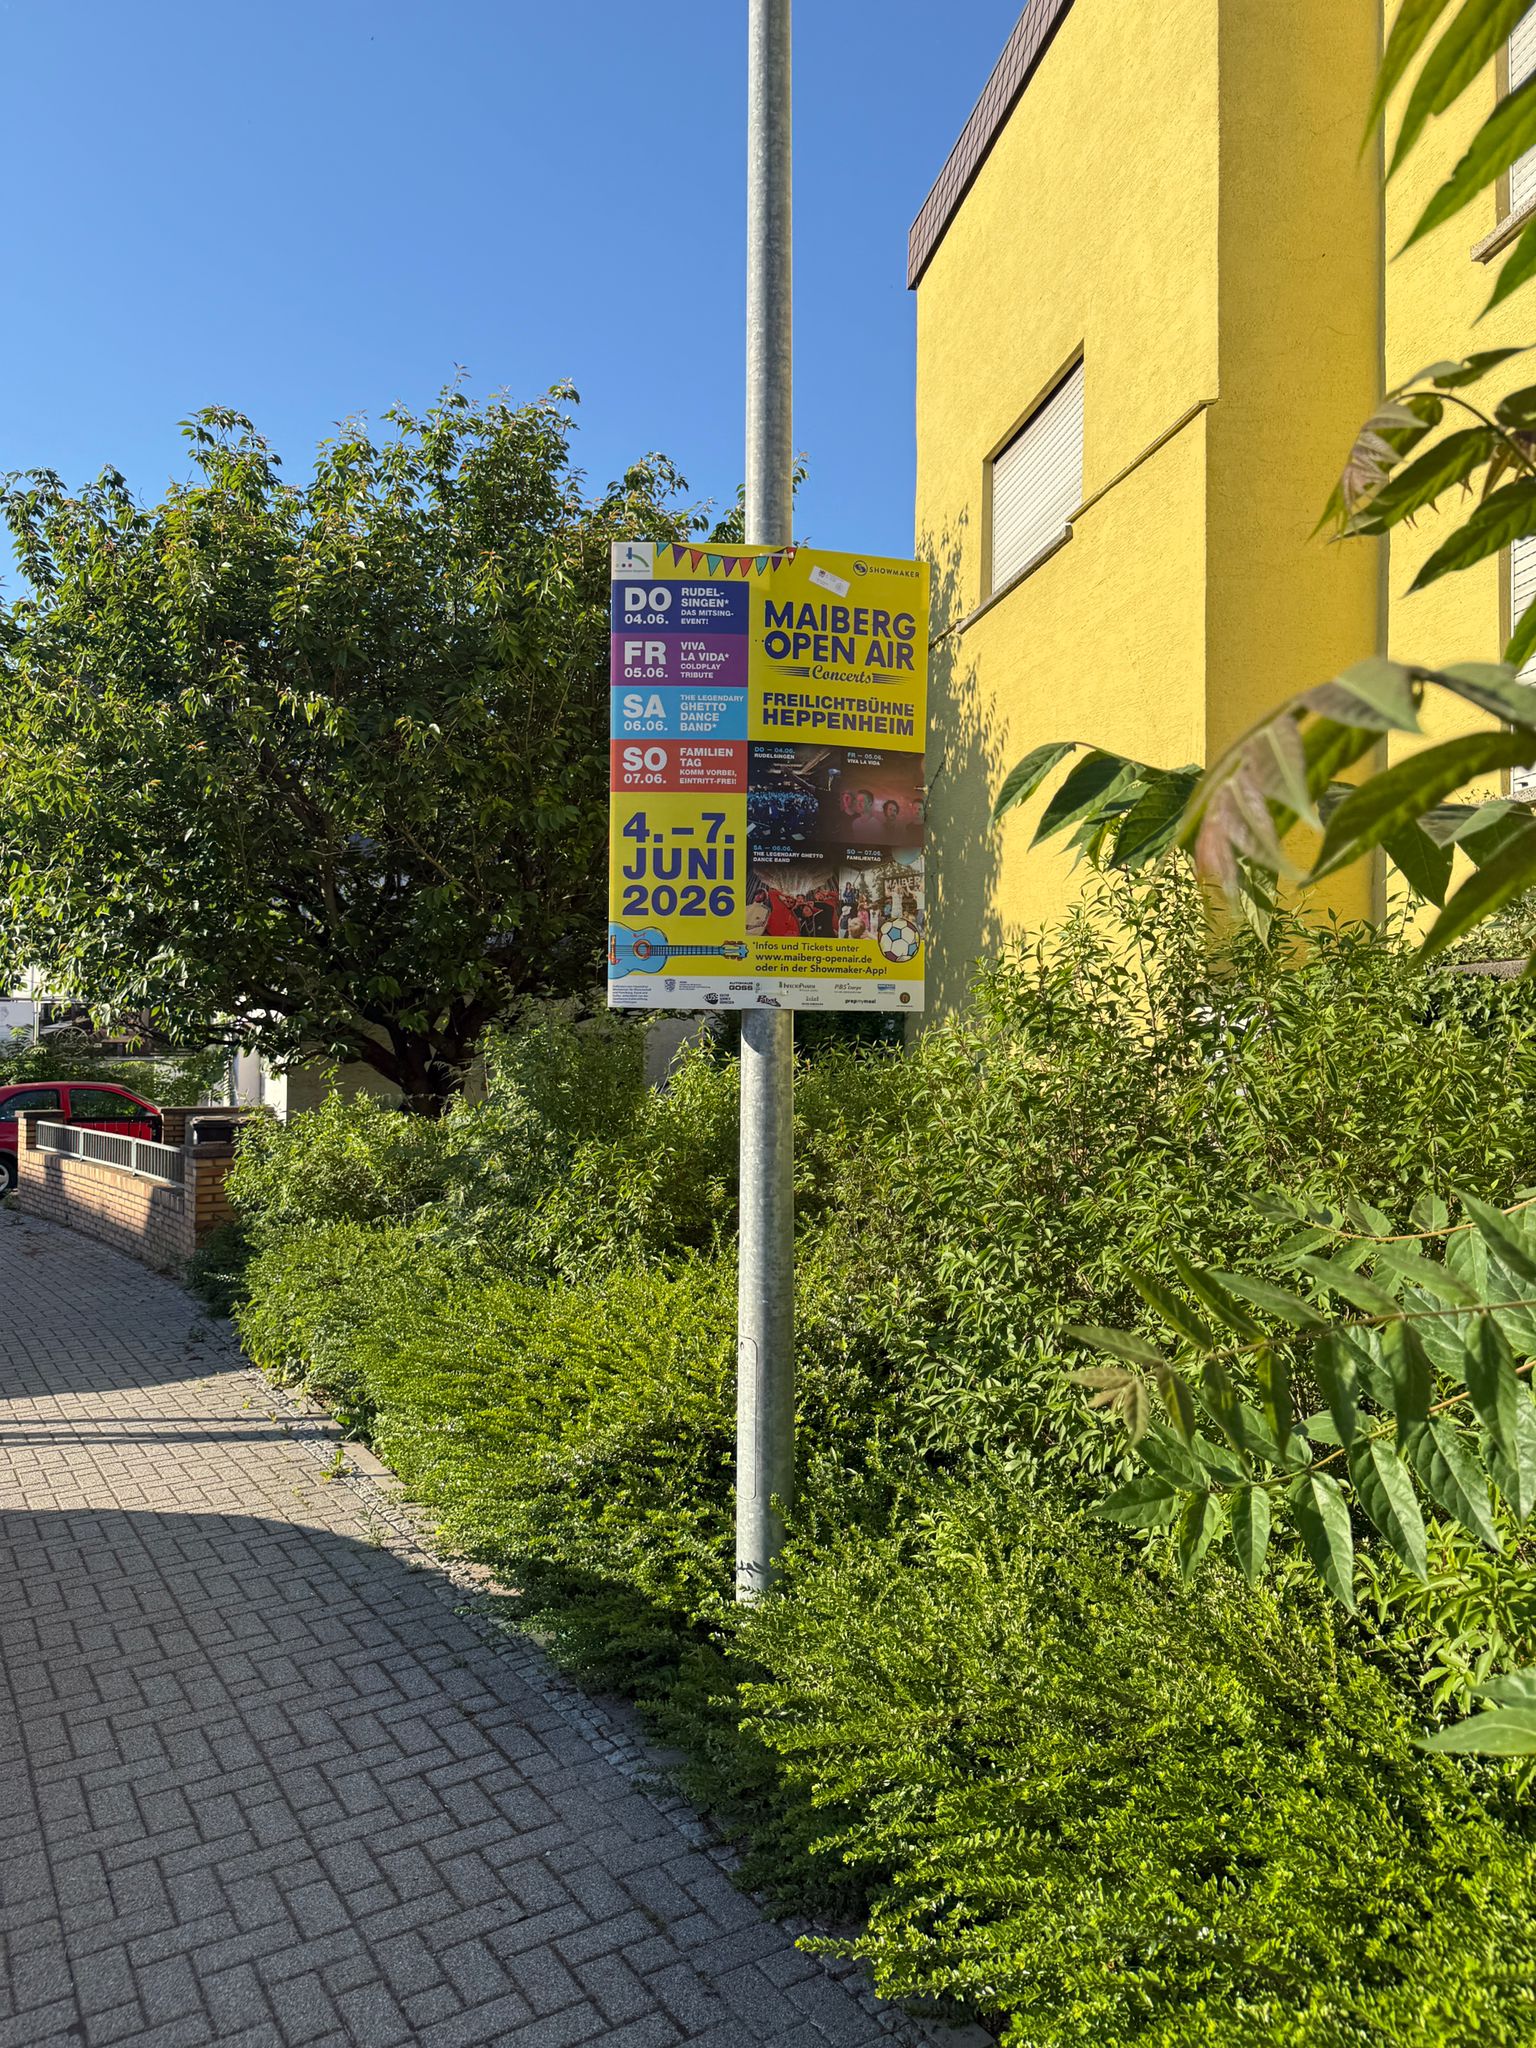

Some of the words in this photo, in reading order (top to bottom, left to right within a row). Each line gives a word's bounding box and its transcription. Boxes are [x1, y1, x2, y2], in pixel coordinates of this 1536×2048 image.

[869, 566, 920, 578] SHOWMAKER
[681, 588, 724, 597] RUDEL-
[625, 587, 672, 611] DO
[624, 614, 669, 625] 04.06.
[764, 600, 916, 641] MAIBERG
[680, 642, 706, 651] VIVA
[764, 630, 855, 665] OPEN
[865, 640, 915, 671] AIR
[624, 641, 667, 665] FR
[681, 652, 696, 661] LA
[624, 668, 669, 678] 05.06.
[811, 664, 872, 684] Concerts
[623, 694, 667, 718] SA
[680, 702, 727, 711] GHETTO
[763, 692, 914, 717] FREILICHTBÜHNE
[680, 712, 720, 721] DANCE
[762, 708, 914, 736] HEPPENHEIM
[624, 721, 668, 731] 06.06.
[680, 747, 734, 757] FAMILIEN
[622, 747, 668, 771] SO
[680, 758, 702, 767] TAG
[706, 769, 737, 777] VORBEI,
[623, 774, 667, 784] 07.06.
[623, 848, 735, 880] JUNI
[622, 884, 735, 917] 2026
[781, 942, 799, 950] und
[801, 942, 833, 952] Tickets
[836, 944, 860, 952] unter
[755, 953, 872, 964] www.maiberg-openair.de
[755, 963, 778, 972] oder
[780, 964, 789, 972] in
[792, 964, 807, 973] der
[810, 964, 887, 976] Showmaker-App!
